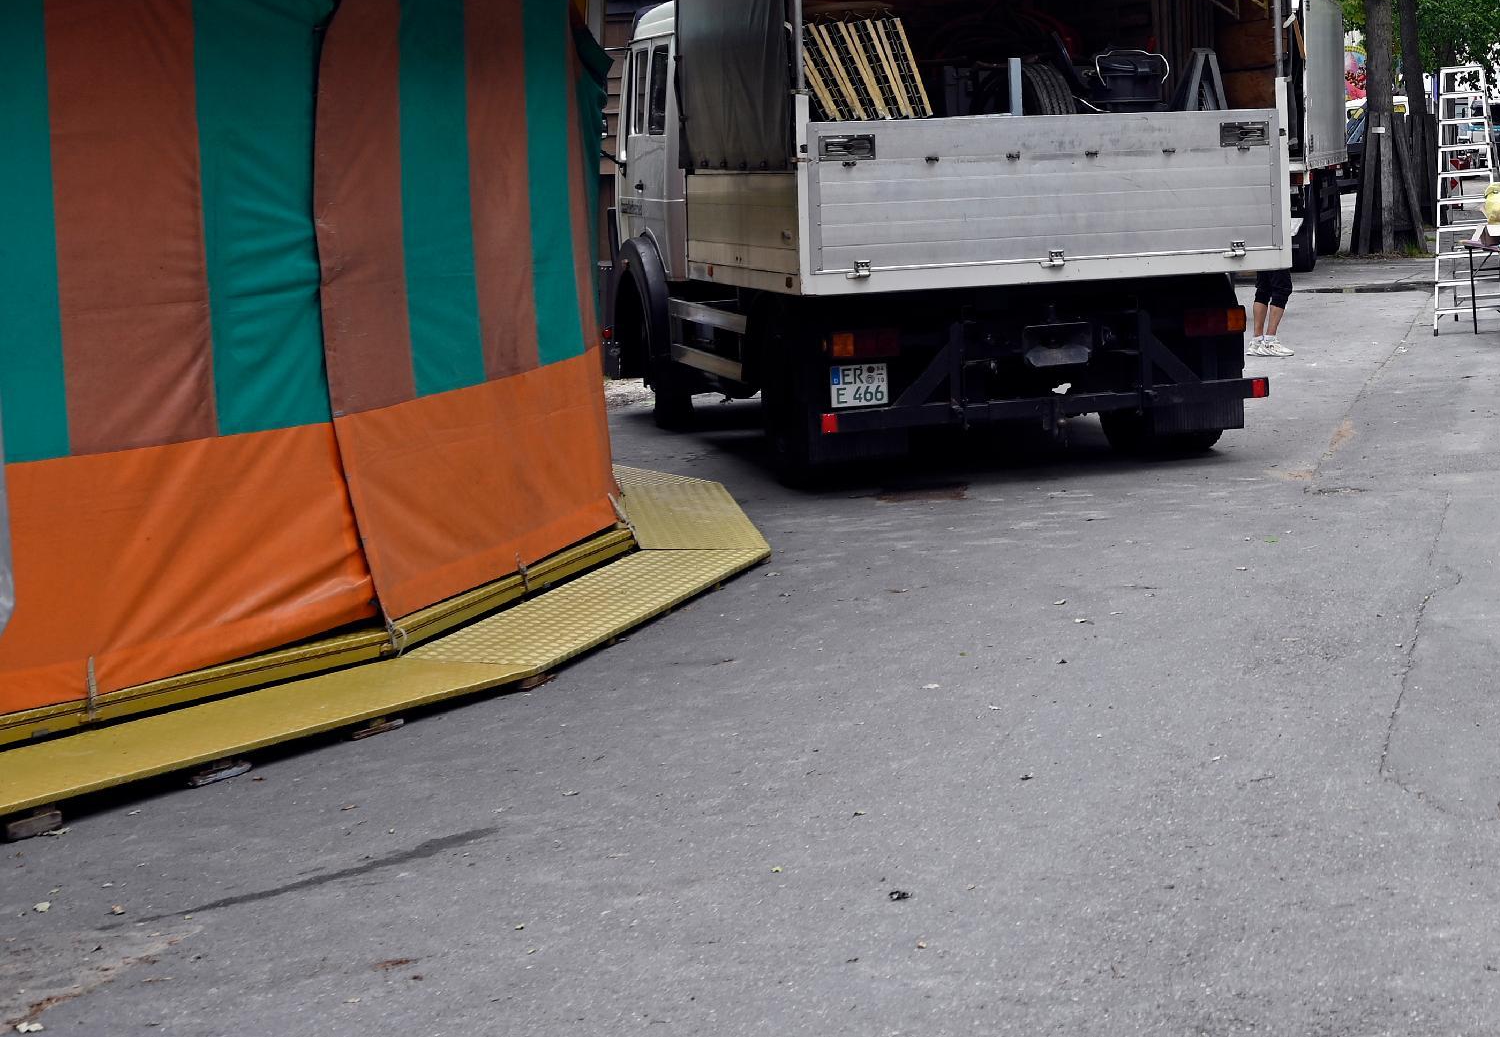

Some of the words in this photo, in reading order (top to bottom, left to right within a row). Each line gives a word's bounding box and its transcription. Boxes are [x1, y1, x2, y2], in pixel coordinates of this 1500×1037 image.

[842, 367, 864, 385] ER
[836, 387, 848, 405] E
[853, 384, 885, 403] 466
